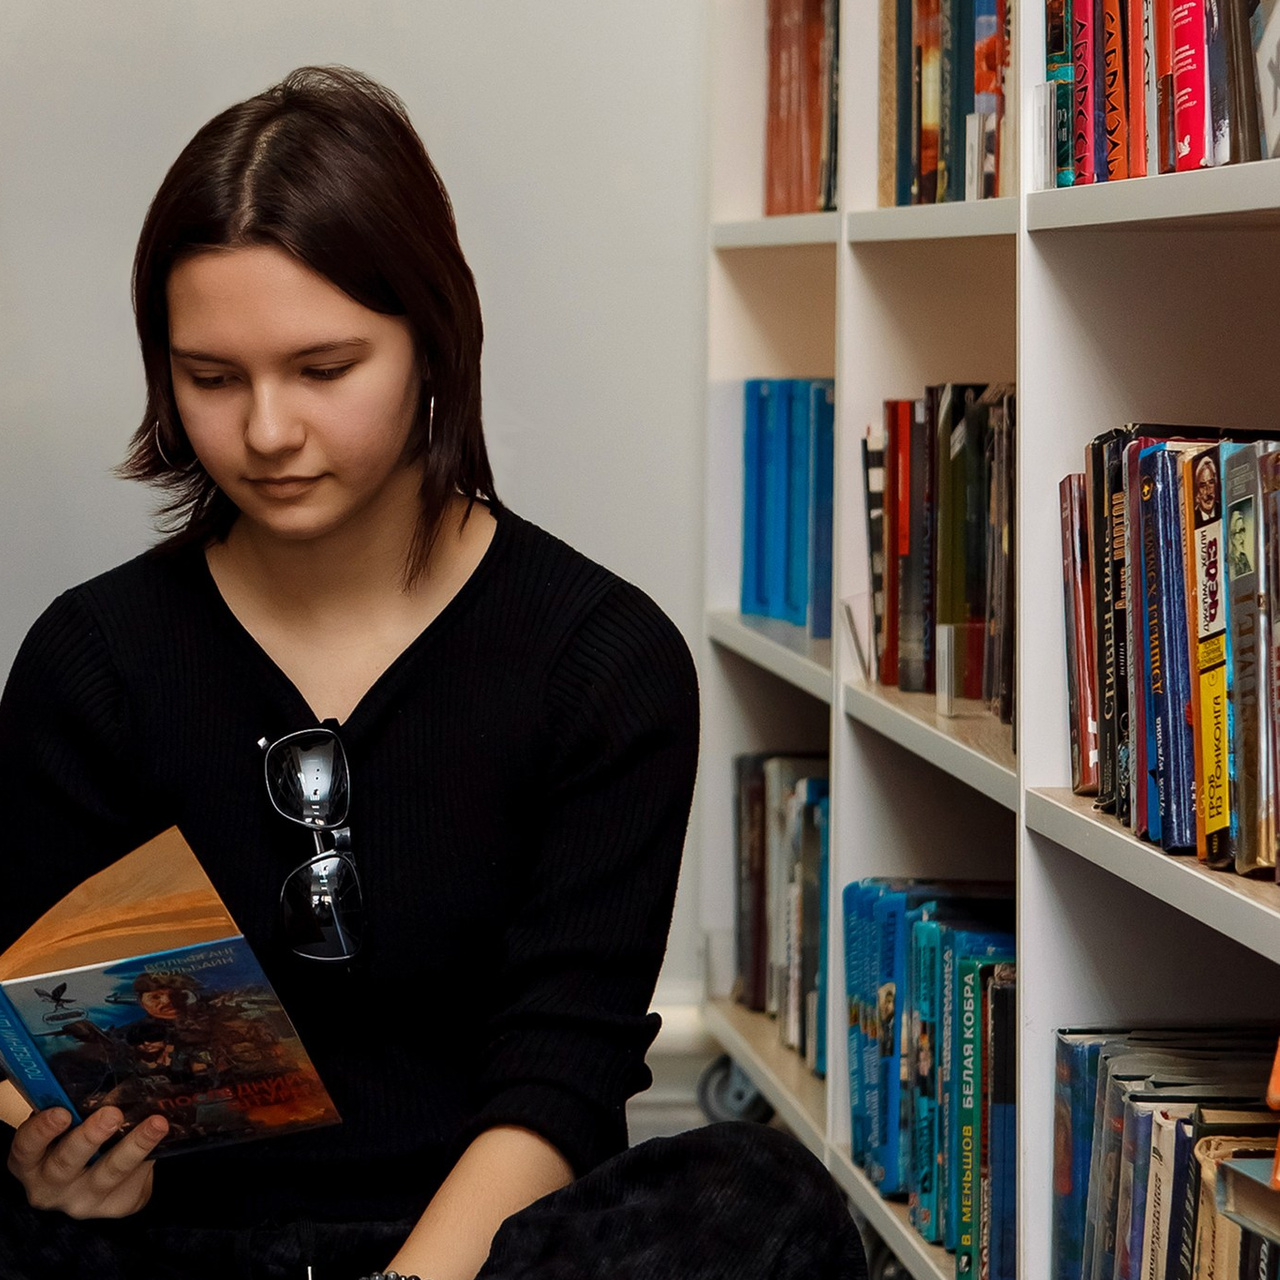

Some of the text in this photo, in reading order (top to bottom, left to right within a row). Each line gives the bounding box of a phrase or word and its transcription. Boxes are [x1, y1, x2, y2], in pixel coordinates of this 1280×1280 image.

[1104, 611, 1115, 720] СТИВЕН
[1155, 716, 1164, 771] МУЖЧИНА
[1213, 694, 1223, 816] ИЗ ГОНКОНГА
[1208, 773, 1216, 820] ГРОБ
[962, 972, 974, 1108] БЕЛАЯ КОБРА
[961, 1124, 972, 1222] МЕНЬШОВ
